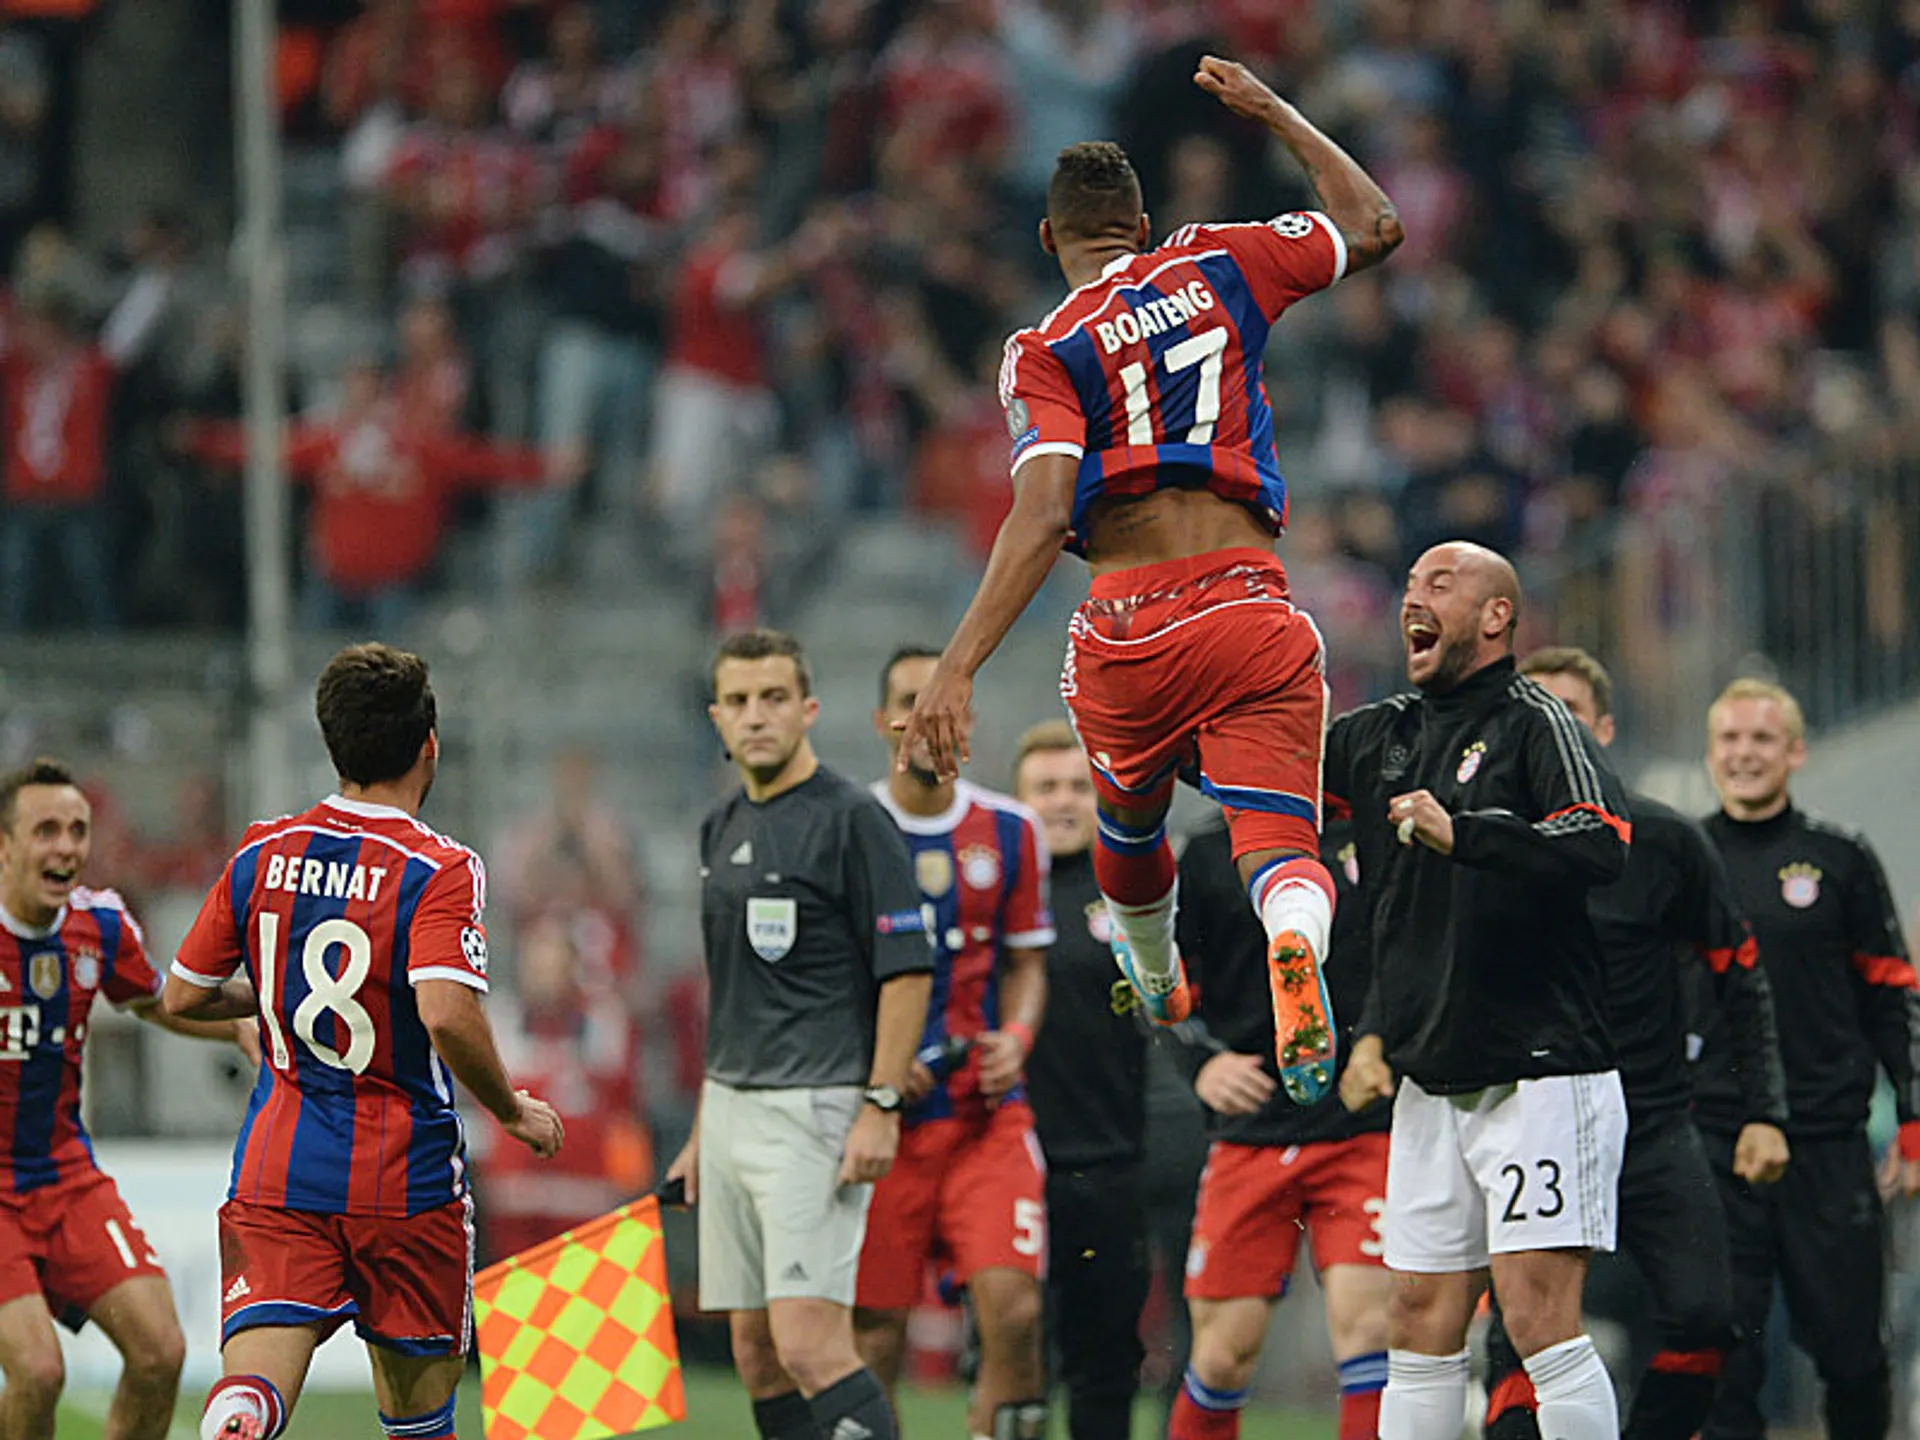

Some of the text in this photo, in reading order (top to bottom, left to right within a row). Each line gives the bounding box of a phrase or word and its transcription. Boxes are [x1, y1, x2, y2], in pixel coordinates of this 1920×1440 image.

[1095, 280, 1214, 355] BOATENG
[1118, 326, 1229, 446] 17
[265, 855, 387, 901] BERNAT
[755, 923, 786, 937] FIFA
[259, 911, 376, 1076] 18
[1501, 1158, 1564, 1223] 23
[1012, 1197, 1044, 1256] 5
